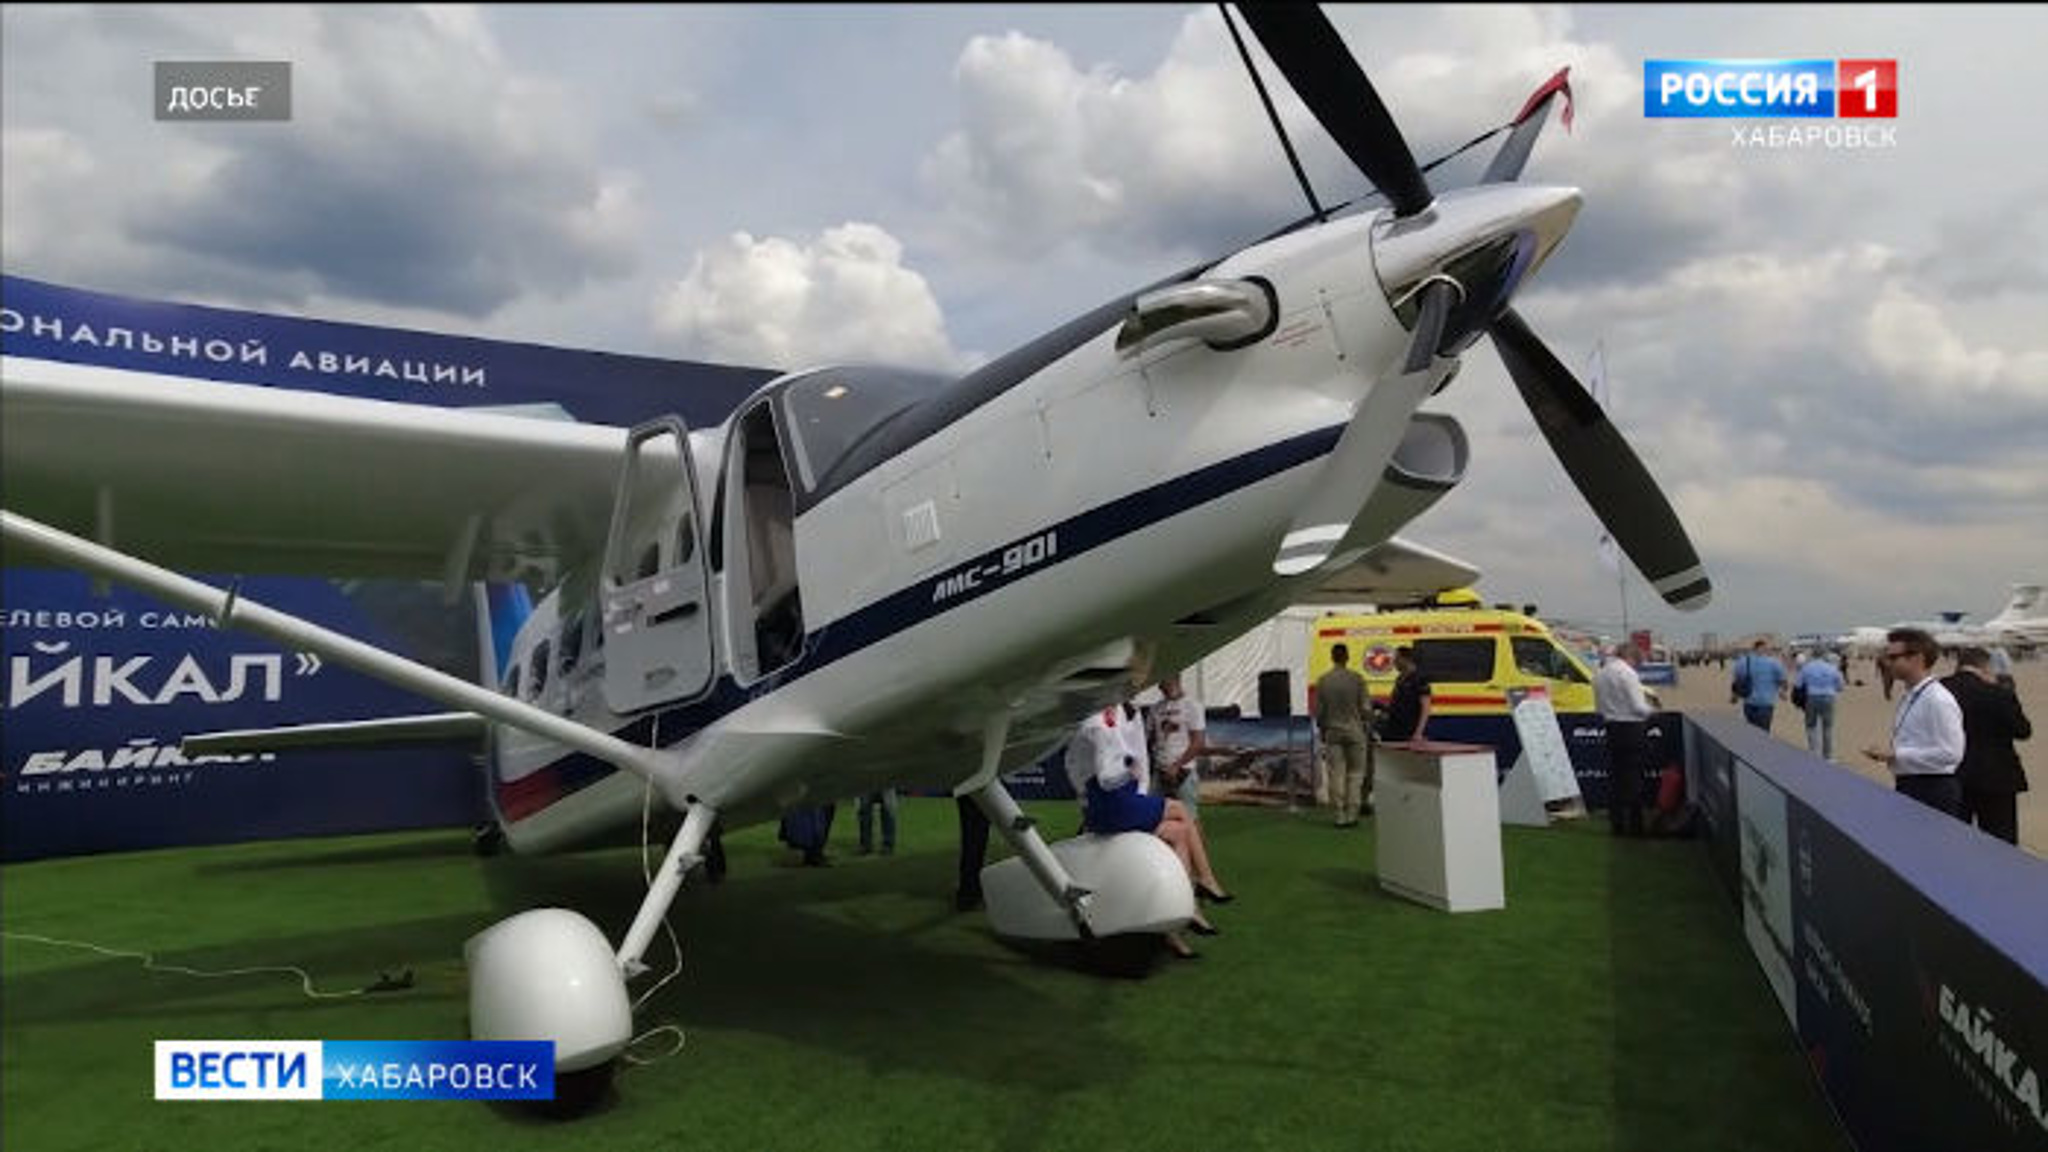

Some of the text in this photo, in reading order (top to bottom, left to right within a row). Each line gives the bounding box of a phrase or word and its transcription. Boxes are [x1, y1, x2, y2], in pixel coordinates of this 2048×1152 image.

[0, 309, 485, 387] ОНАЛЬНОЙ АВИАЦИИ
[20, 738, 275, 775] БАЙК
[1939, 984, 2048, 1131] БАЙКА
